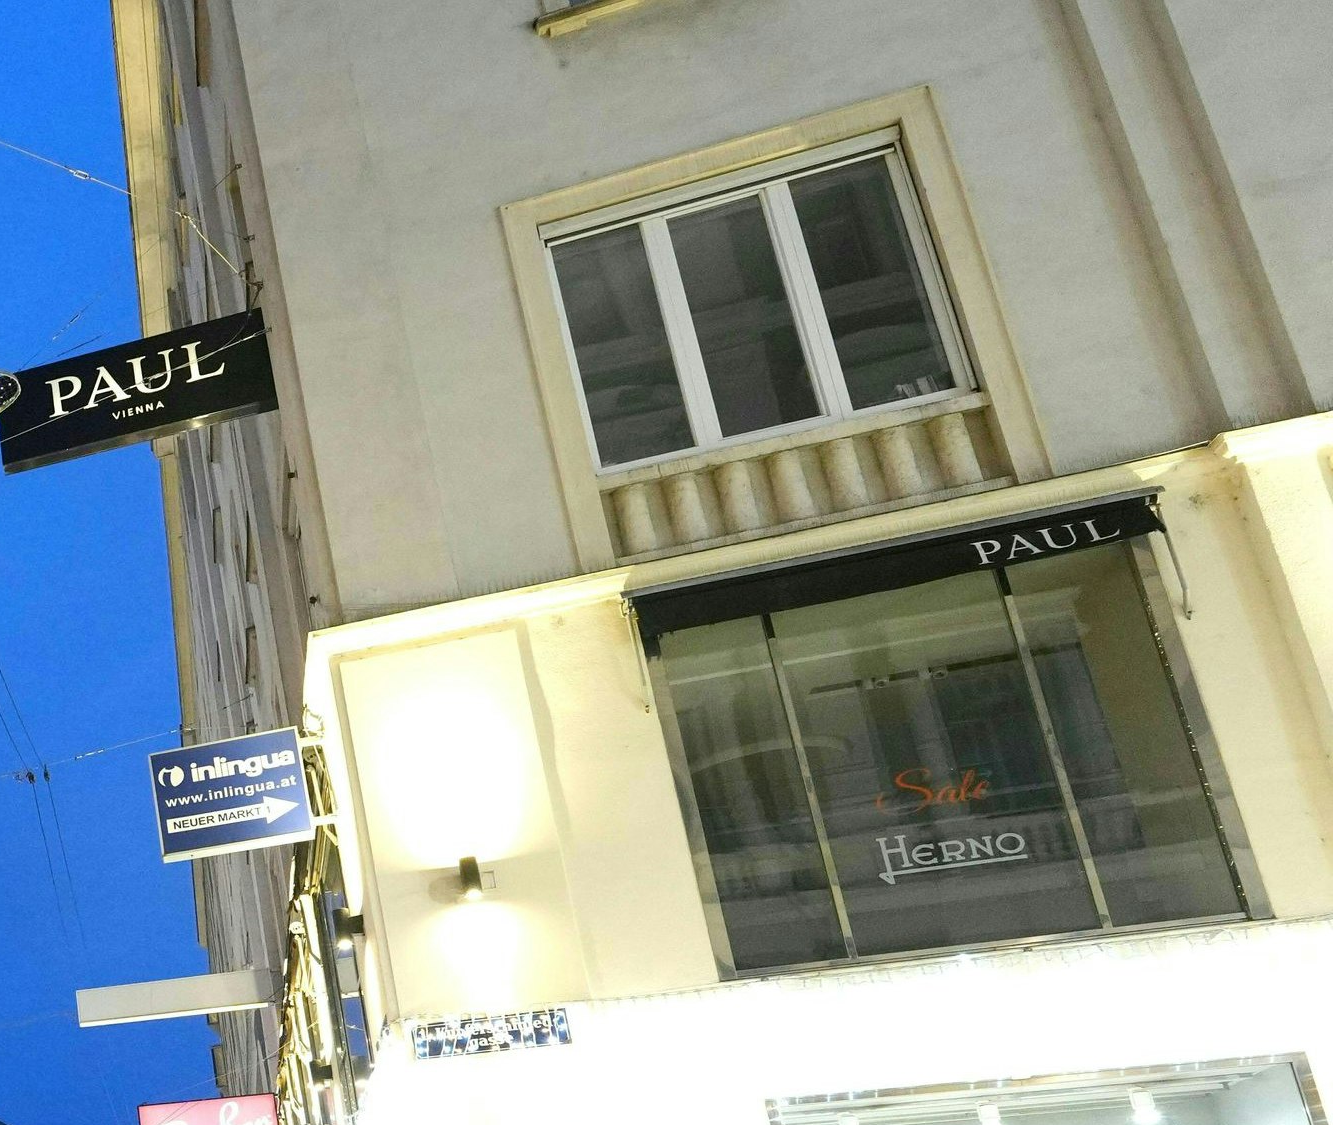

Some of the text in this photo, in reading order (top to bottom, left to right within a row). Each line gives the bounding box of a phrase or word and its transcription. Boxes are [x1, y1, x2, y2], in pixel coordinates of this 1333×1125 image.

[45, 341, 225, 418] PAUL
[112, 400, 165, 420] VIENNA
[970, 519, 1121, 565] PAUL
[190, 750, 295, 782] inlingua
[165, 775, 297, 808] www.inlingua.at
[876, 768, 989, 815] Sale
[173, 816, 215, 830] NEUER
[218, 807, 261, 823] MARKT
